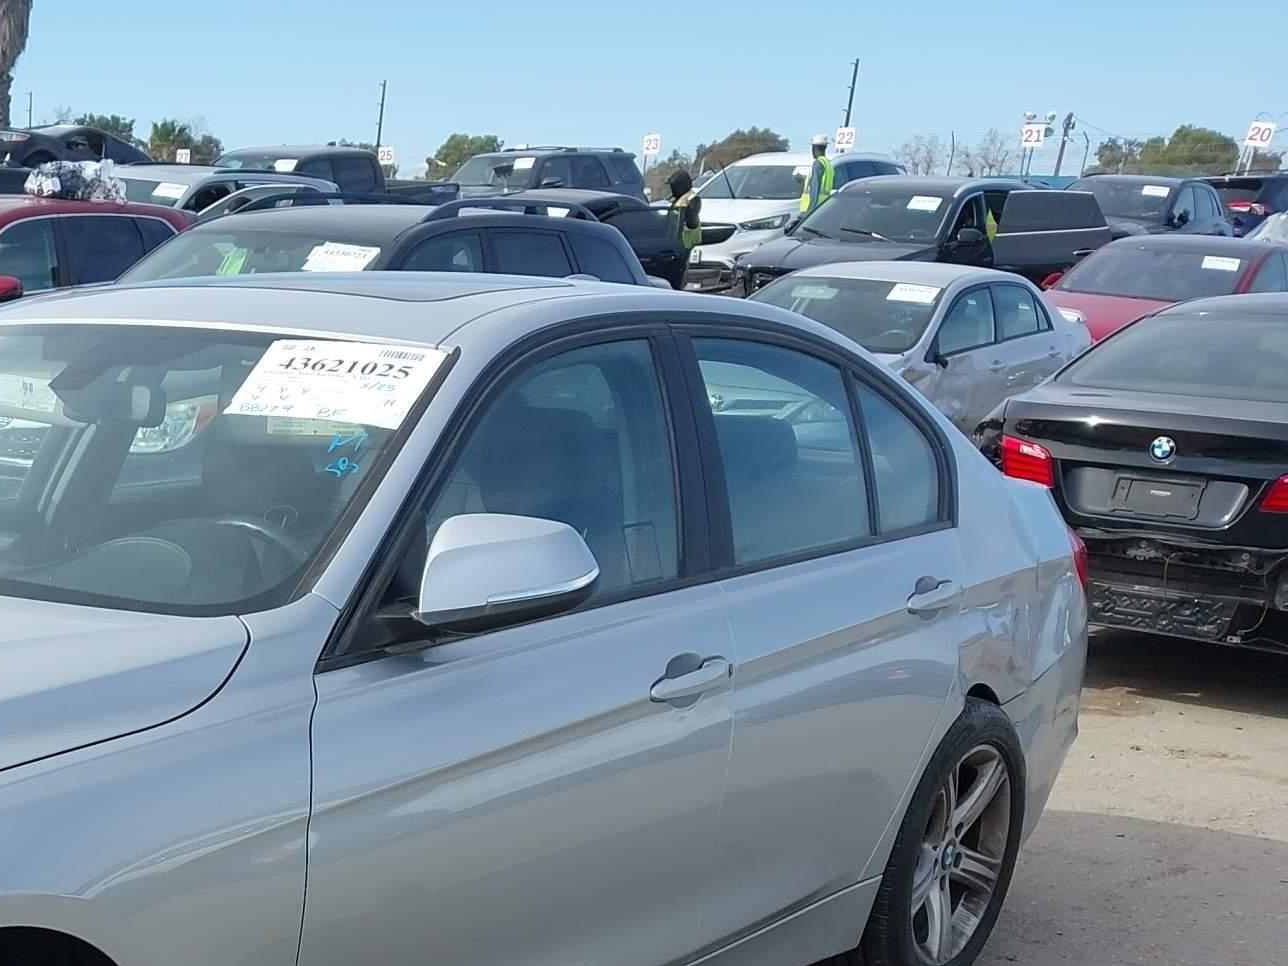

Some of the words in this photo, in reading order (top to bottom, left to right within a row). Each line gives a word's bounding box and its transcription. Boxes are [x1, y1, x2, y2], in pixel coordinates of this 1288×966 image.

[837, 132, 853, 144] 22
[1024, 128, 1042, 142] 21
[1248, 126, 1272, 142] 20
[177, 152, 189, 162] 27
[380, 150, 393, 161] 25
[279, 357, 414, 380] 43621025
